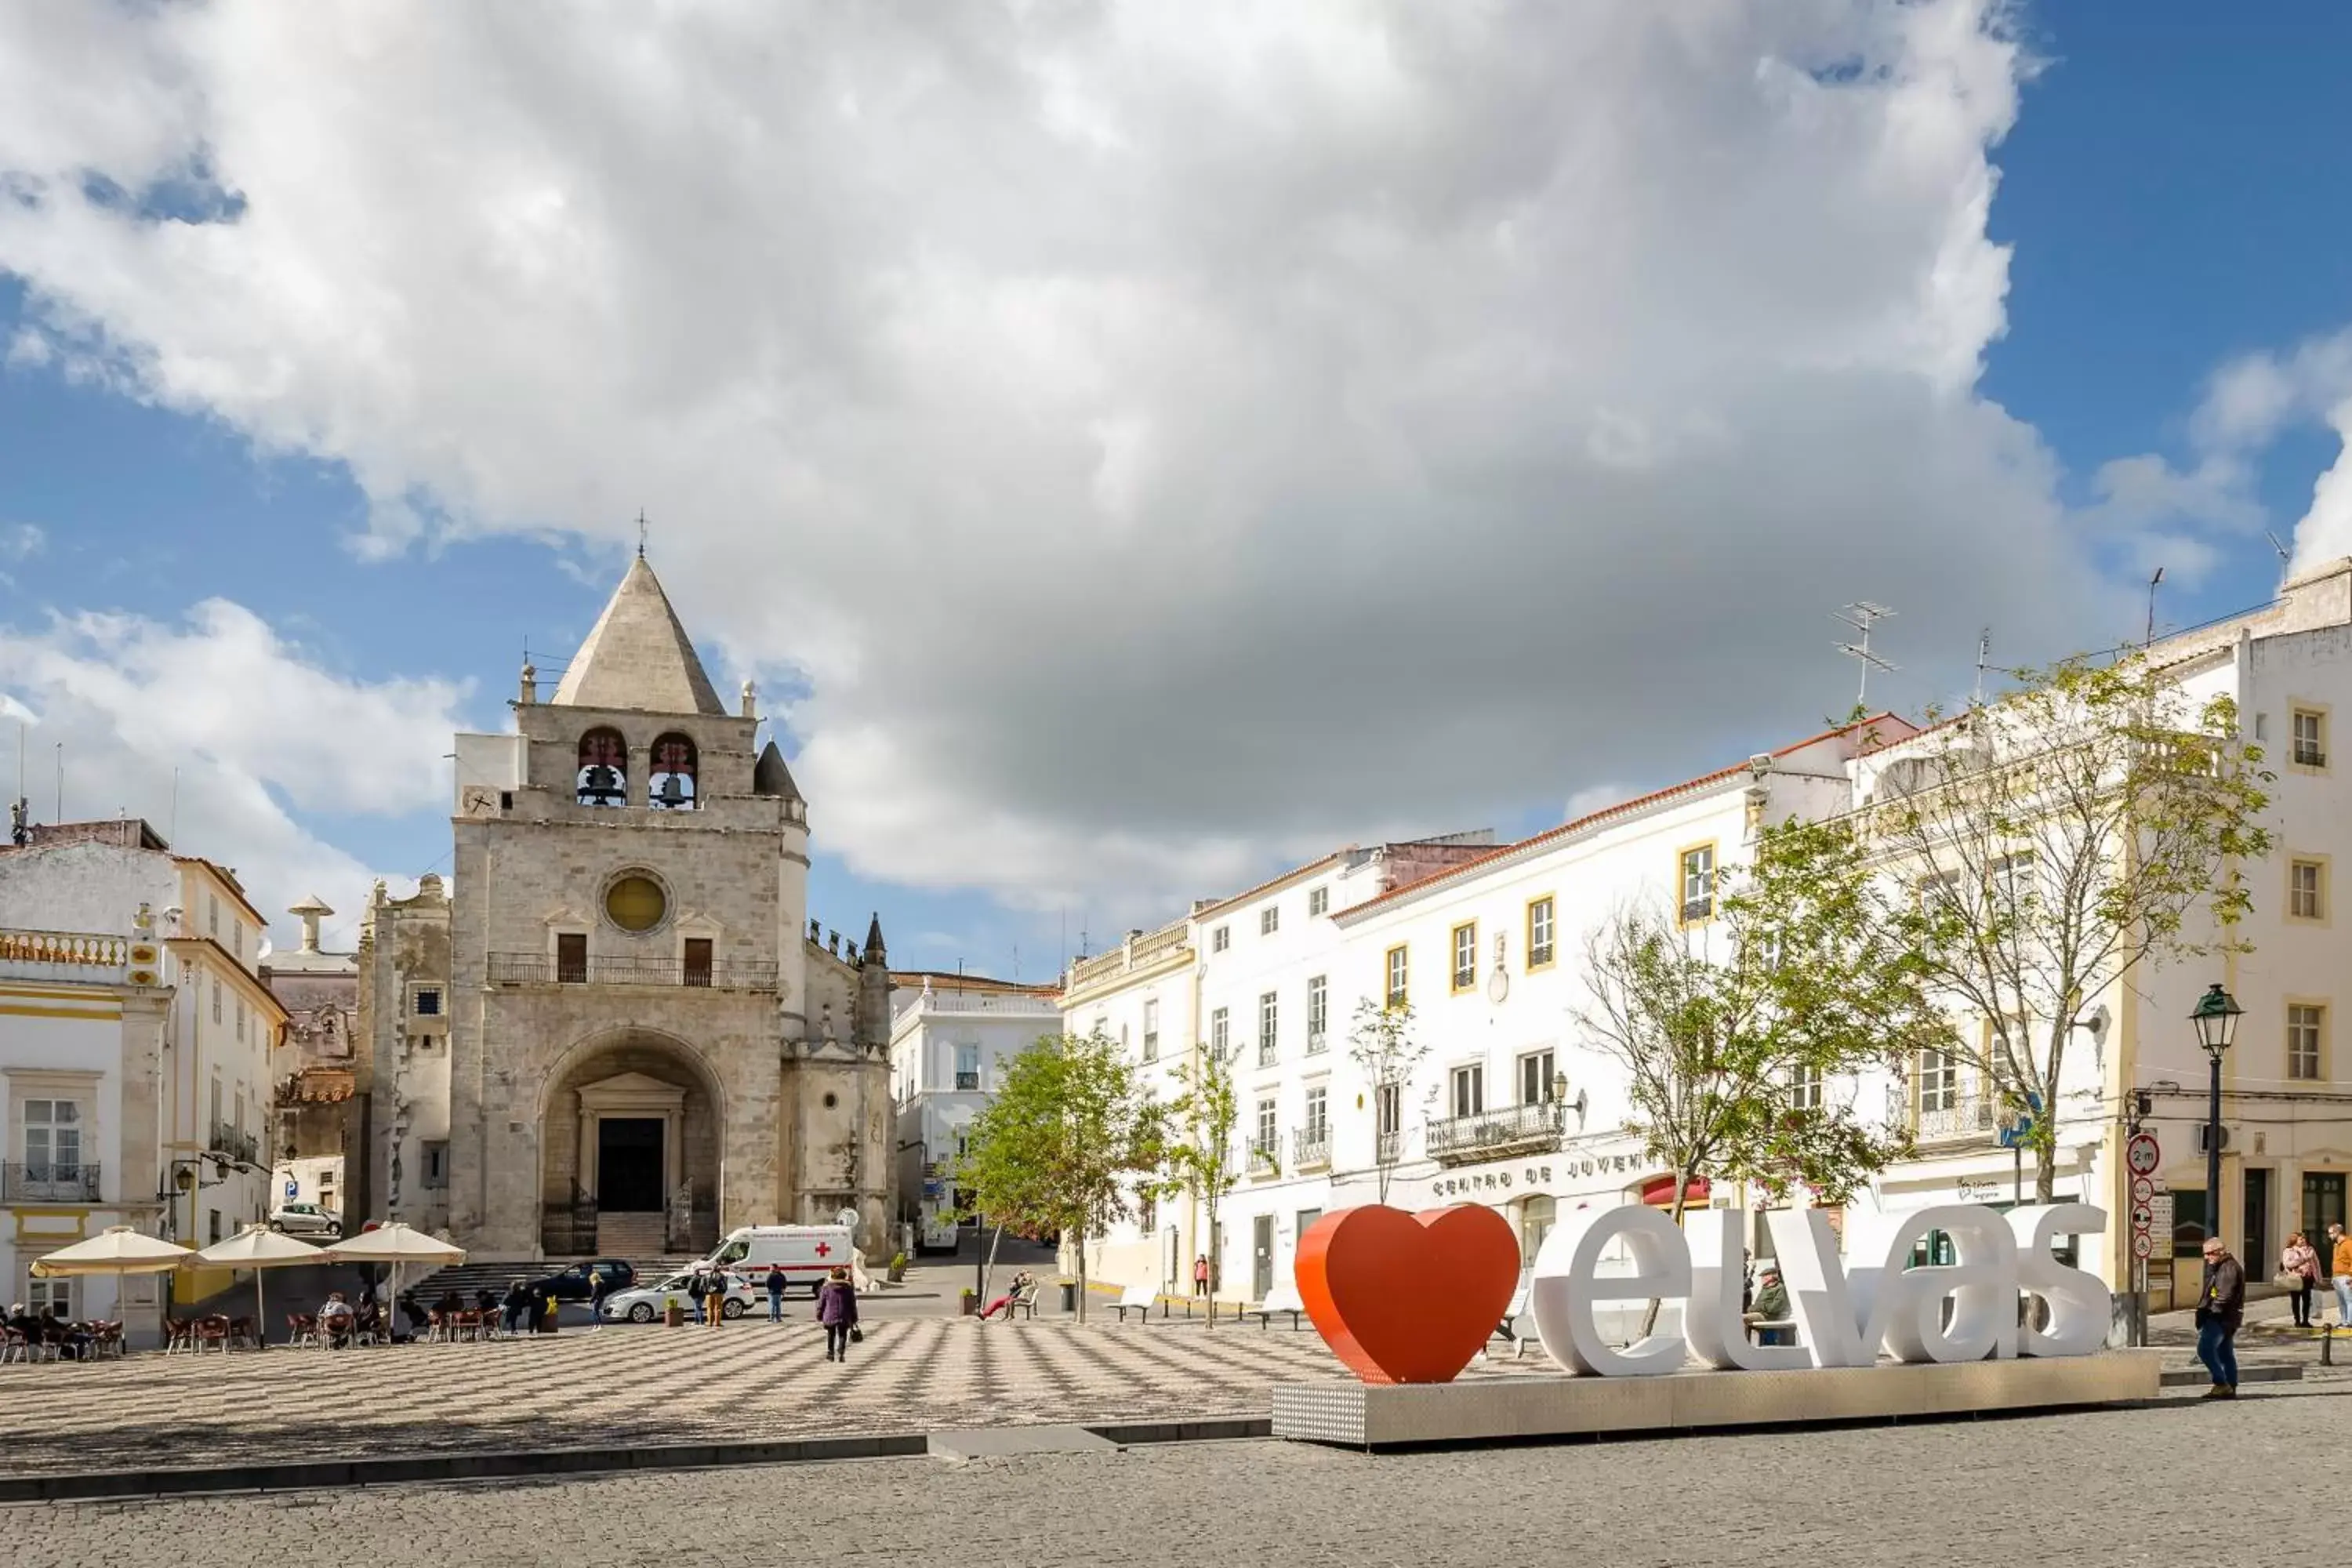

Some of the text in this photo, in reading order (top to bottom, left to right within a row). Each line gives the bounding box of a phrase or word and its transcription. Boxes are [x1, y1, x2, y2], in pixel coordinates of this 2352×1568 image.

[2133, 1150, 2140, 1161] 2
[288, 1181, 296, 1196] P
[1432, 1153, 1657, 1197] CENTRO DE JUVEN
[1534, 1203, 2112, 1377] elvas
